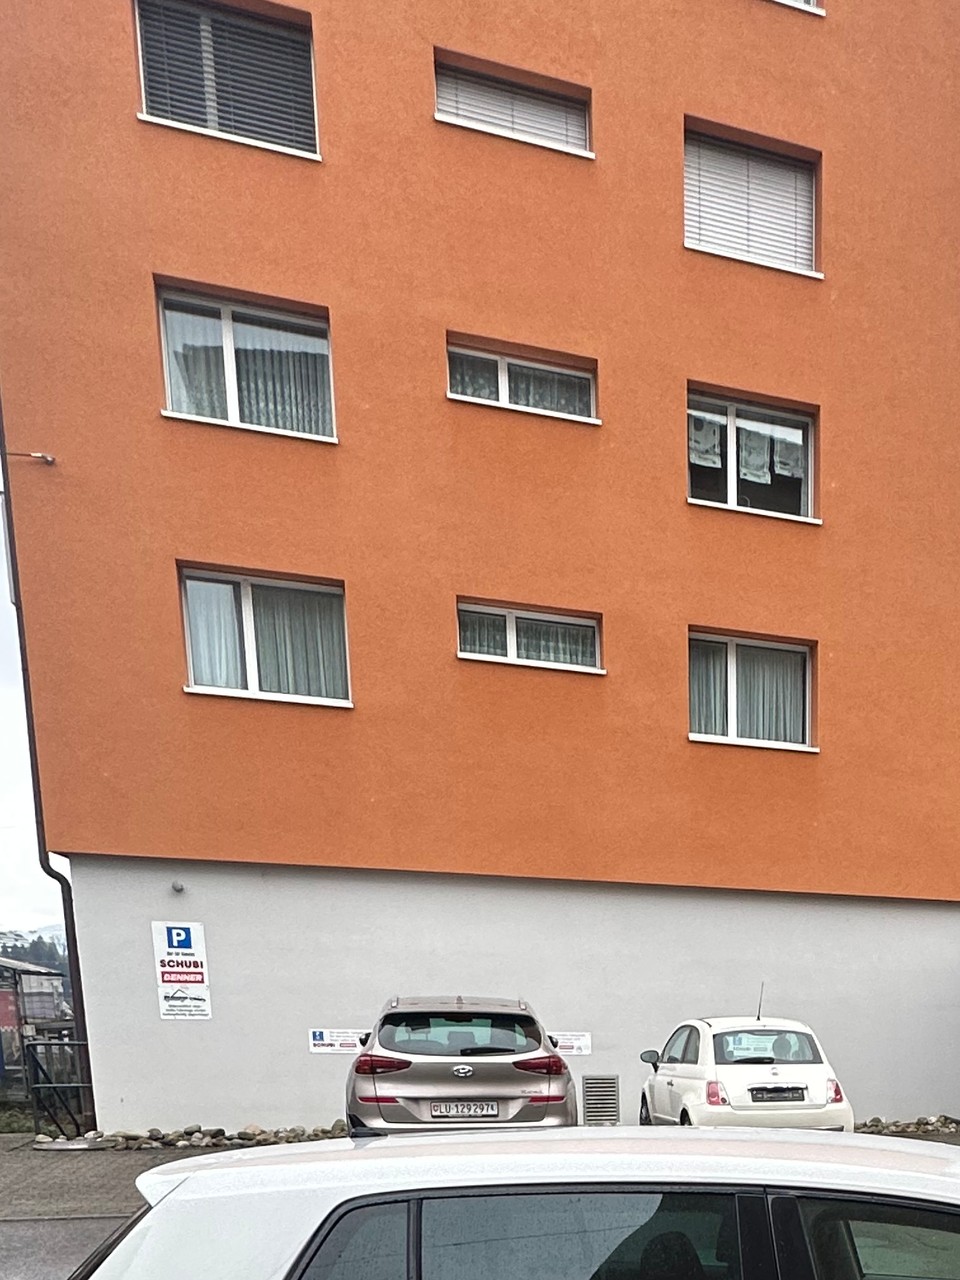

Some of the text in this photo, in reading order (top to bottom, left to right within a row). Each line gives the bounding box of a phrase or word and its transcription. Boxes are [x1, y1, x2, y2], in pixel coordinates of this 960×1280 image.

[171, 928, 186, 947] P
[160, 959, 203, 969] SCHUBI
[163, 973, 203, 982] DENNER
